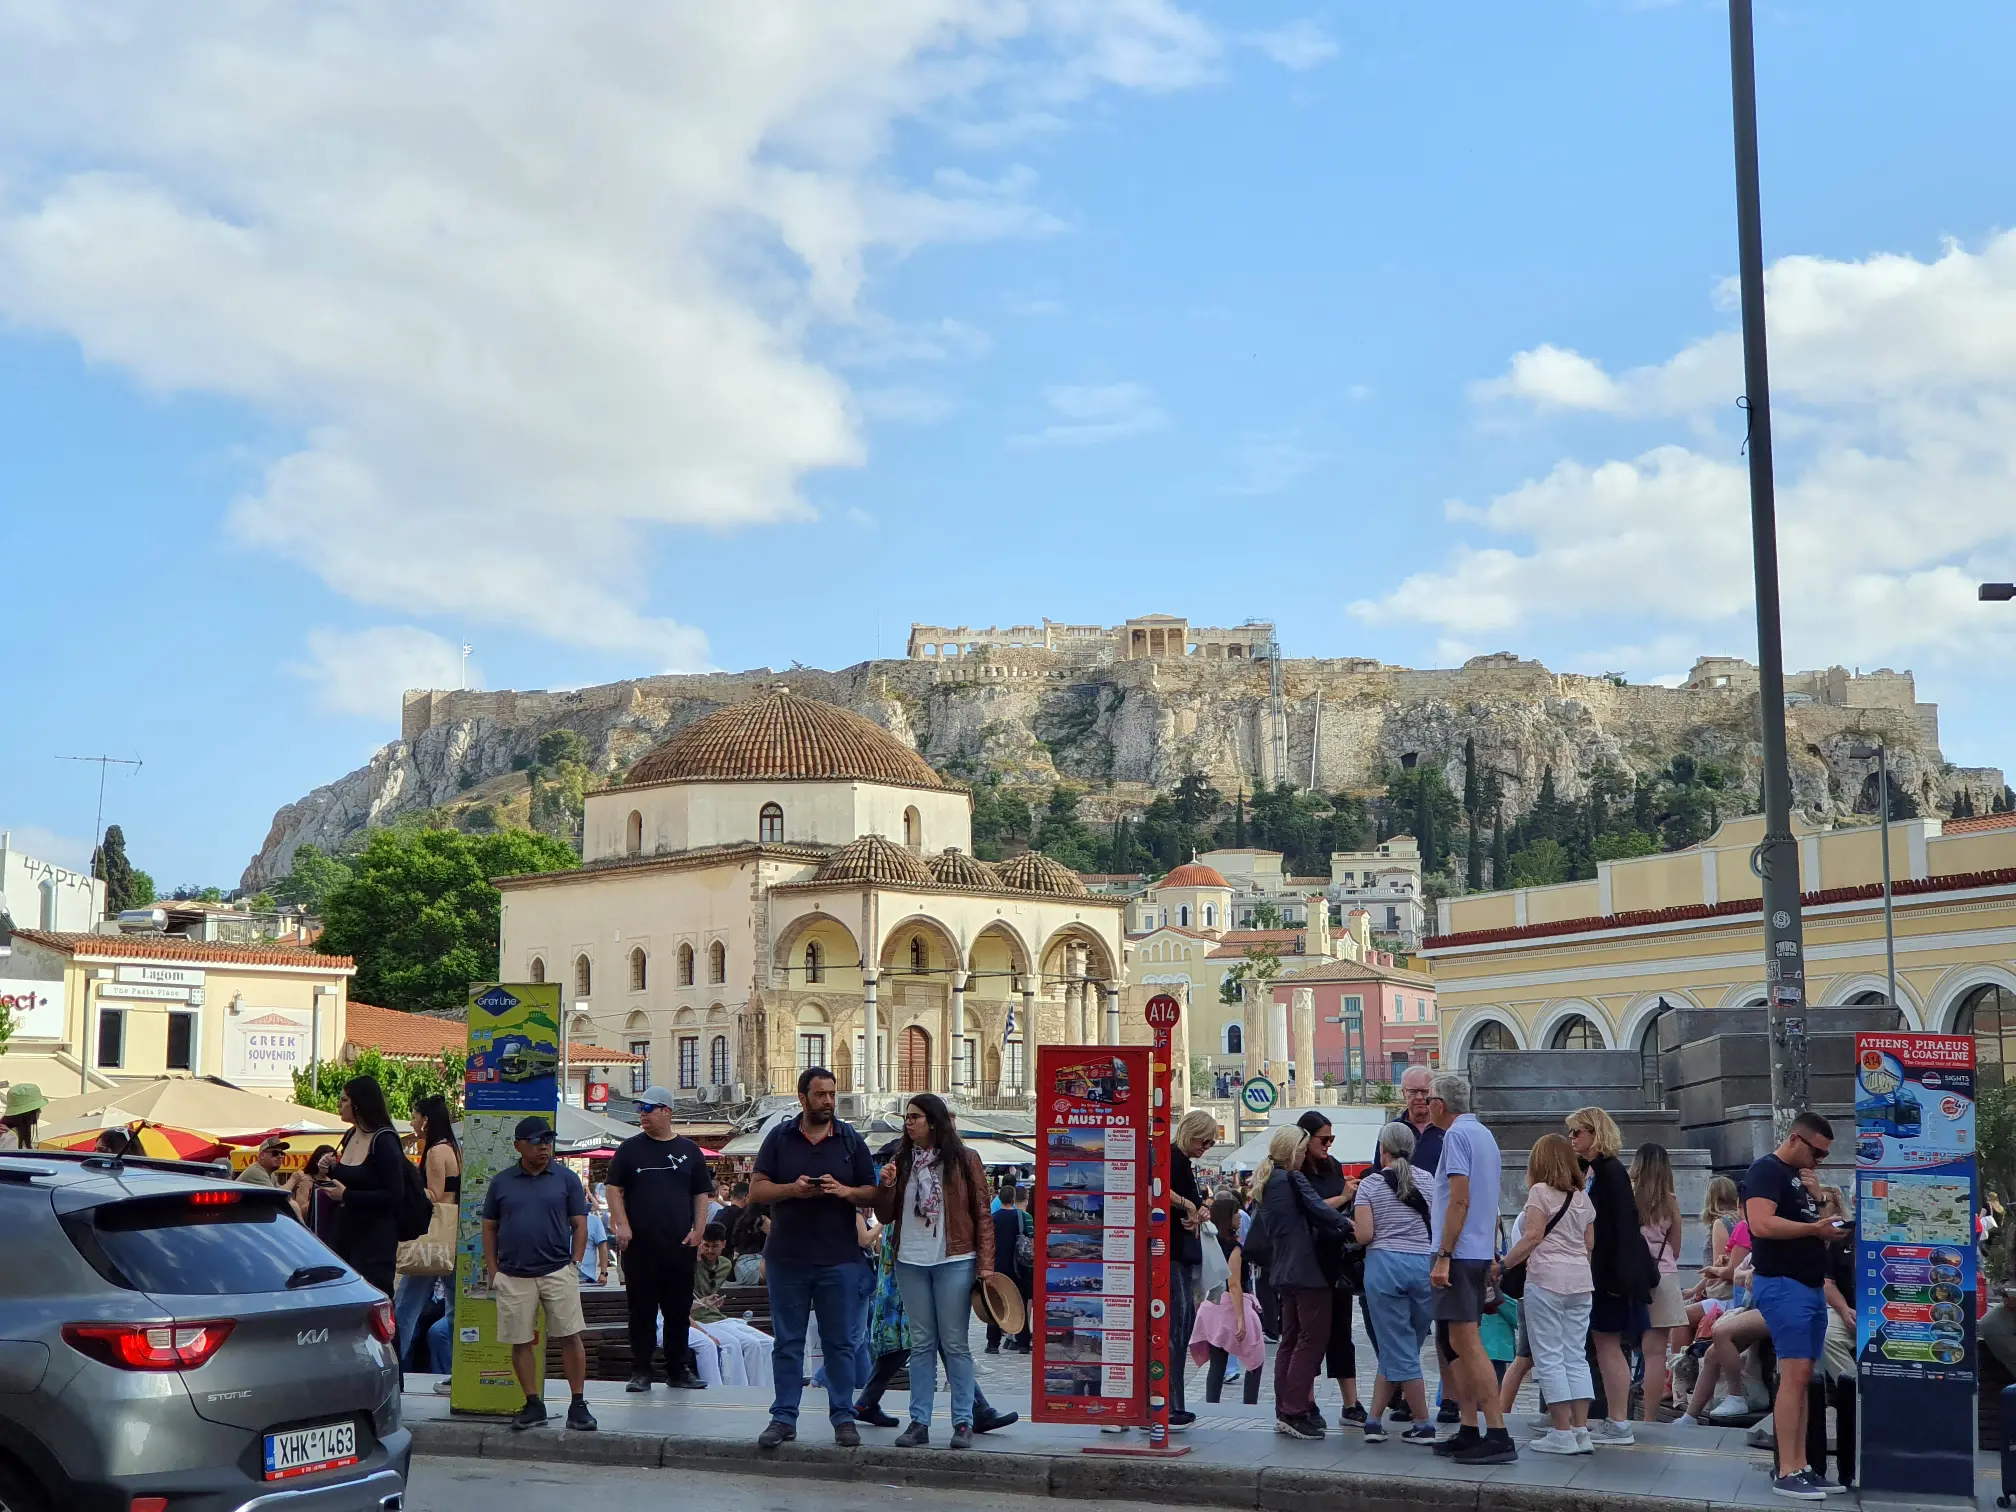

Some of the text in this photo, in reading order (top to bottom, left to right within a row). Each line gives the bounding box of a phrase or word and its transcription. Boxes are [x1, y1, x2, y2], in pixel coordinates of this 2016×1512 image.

[142, 967, 184, 981] Lagom
[158, 988, 179, 997] Place
[1150, 1002, 1176, 1022] A14
[250, 1035, 296, 1046] GREEK
[1860, 1038, 1969, 1051] ATHENS, PIRAEUS
[248, 1049, 296, 1060] SOUVENIRS
[1903, 1050, 1969, 1061] & COASTLINE
[1864, 1056, 1880, 1065] A14
[1055, 1115, 1130, 1126] A MUST DO!
[297, 1328, 329, 1346] KIA
[207, 1390, 253, 1402] STONIC
